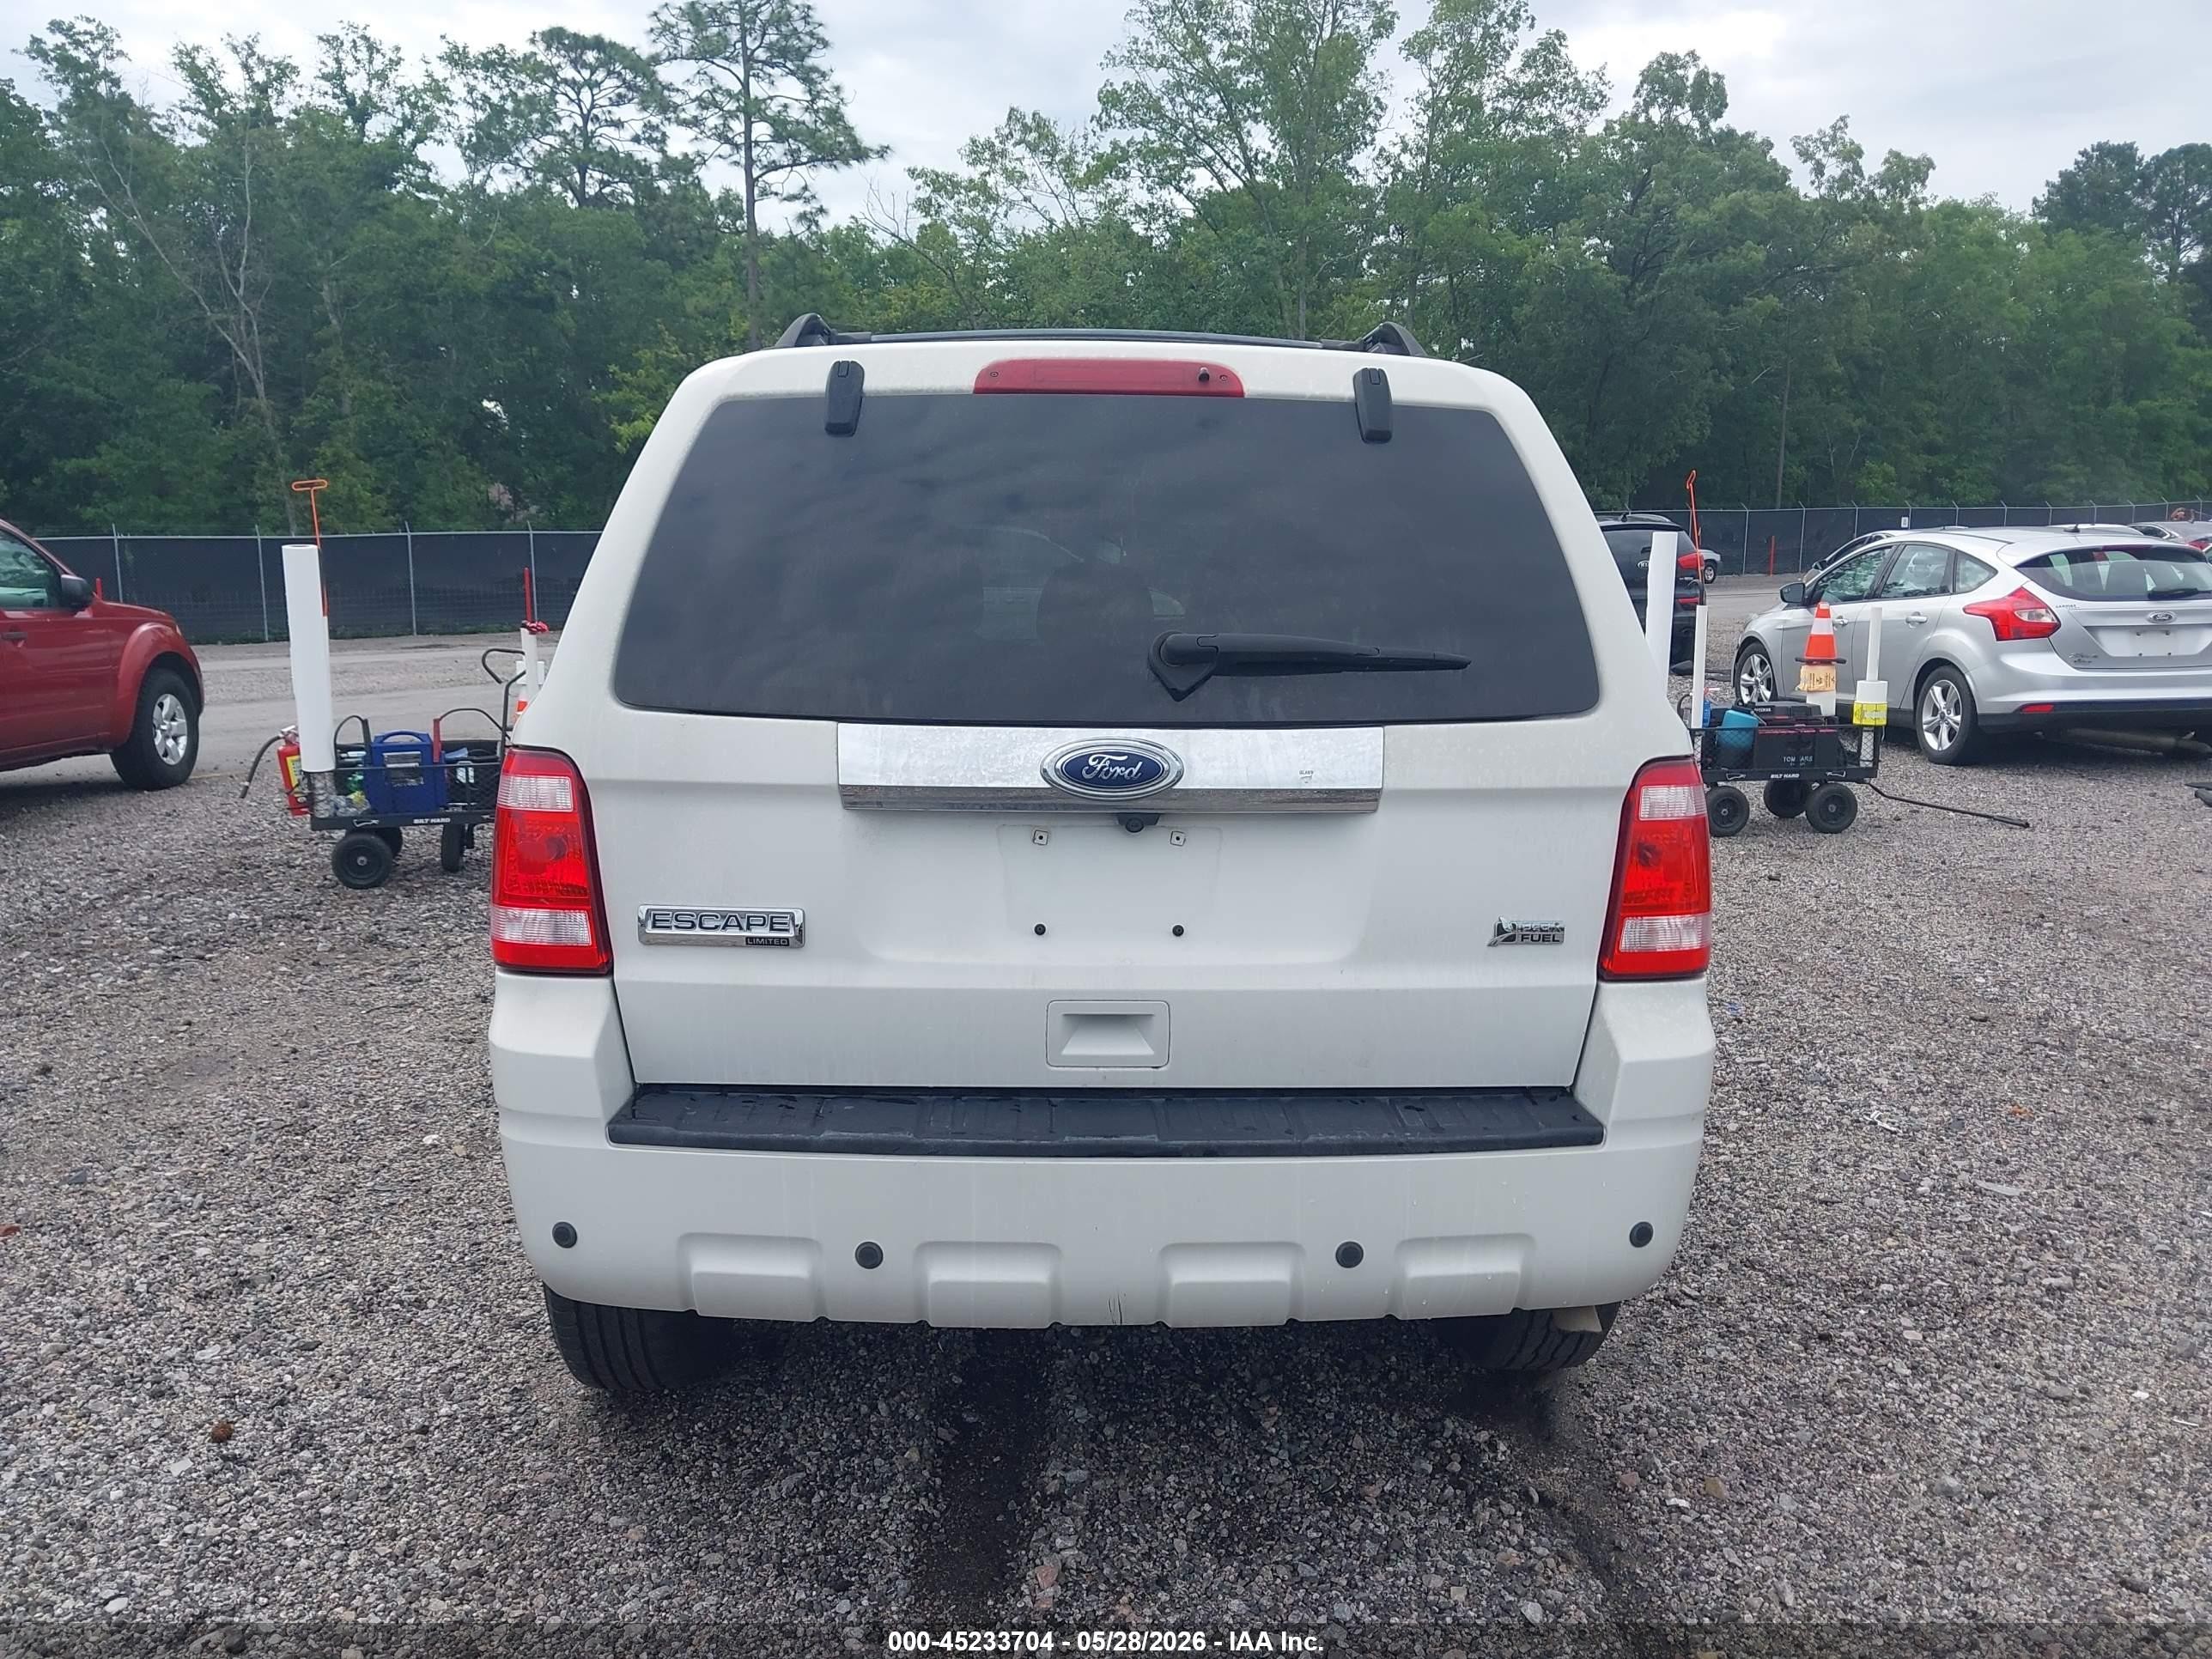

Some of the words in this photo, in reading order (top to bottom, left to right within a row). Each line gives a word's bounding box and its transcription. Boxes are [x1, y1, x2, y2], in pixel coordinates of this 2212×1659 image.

[1082, 754, 1143, 780] Ford
[650, 910, 792, 933] ESCAPE
[747, 937, 788, 945] LIMITED
[1521, 933, 1560, 942] FUEL
